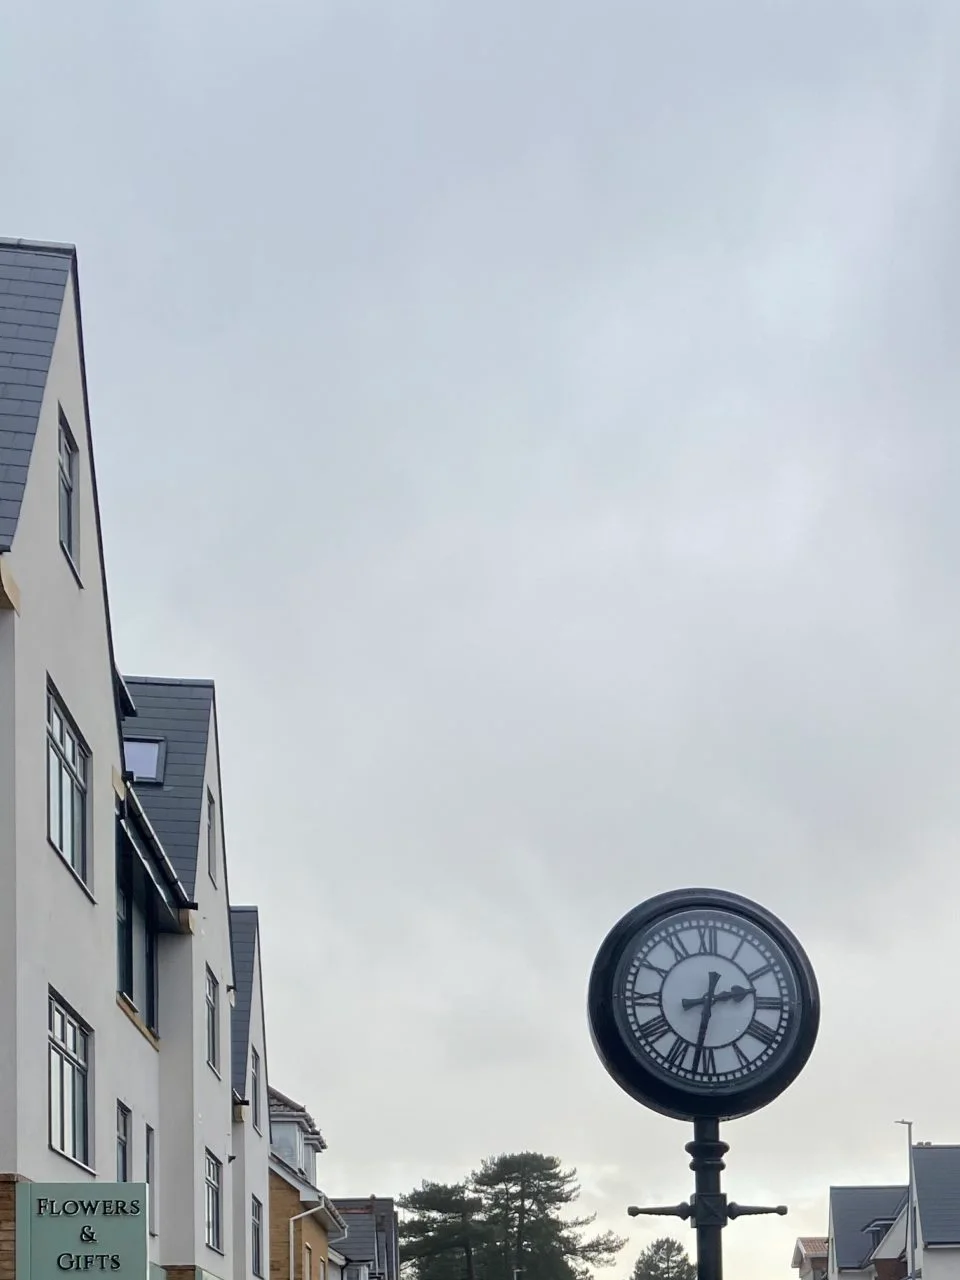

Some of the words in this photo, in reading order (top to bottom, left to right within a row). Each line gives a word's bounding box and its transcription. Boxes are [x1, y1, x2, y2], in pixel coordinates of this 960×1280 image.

[698, 926, 718, 954] XII
[37, 1198, 140, 1216] FLOWERS
[80, 1225, 97, 1242] &
[57, 1253, 121, 1271] GIFTS
